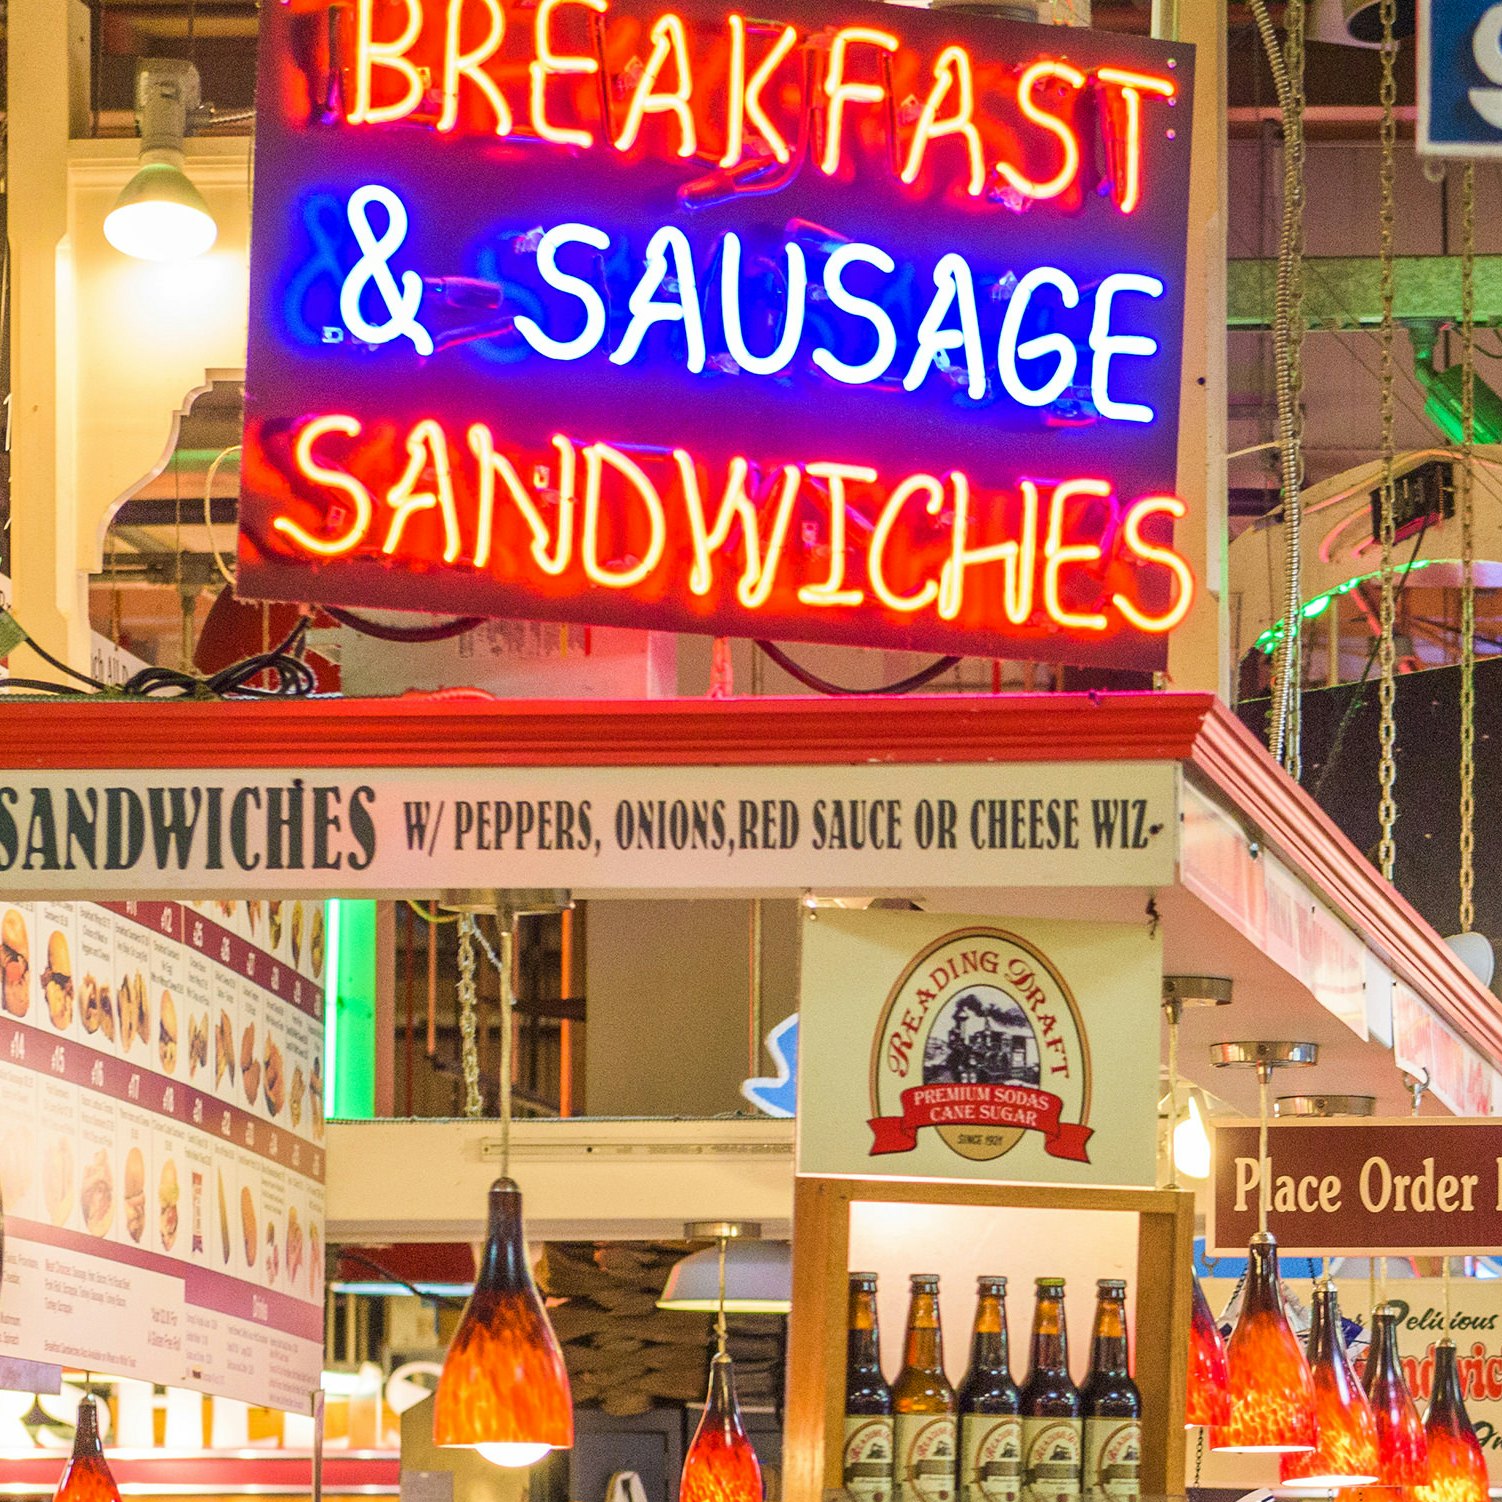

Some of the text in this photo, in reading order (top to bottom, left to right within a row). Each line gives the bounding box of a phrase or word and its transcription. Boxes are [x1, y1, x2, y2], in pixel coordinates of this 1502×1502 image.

[346, 0, 1177, 214] BREAKFAST
[339, 183, 1164, 424] & SAUSAGE
[272, 413, 1195, 633] SANDWICHES
[0, 784, 377, 871] SANDWICHES
[403, 800, 443, 858] W/
[454, 800, 601, 858] PEPPERS,
[811, 799, 902, 850] SAUCE
[914, 799, 958, 850] OR
[969, 799, 1080, 850] CHEESE
[887, 949, 1071, 1080] READING DRAFT
[913, 1086, 1050, 1111] PREMIUM SODAS
[929, 1103, 1038, 1127] CANE SUGAR
[1233, 1156, 1343, 1213] Place
[1358, 1156, 1479, 1213] Order
